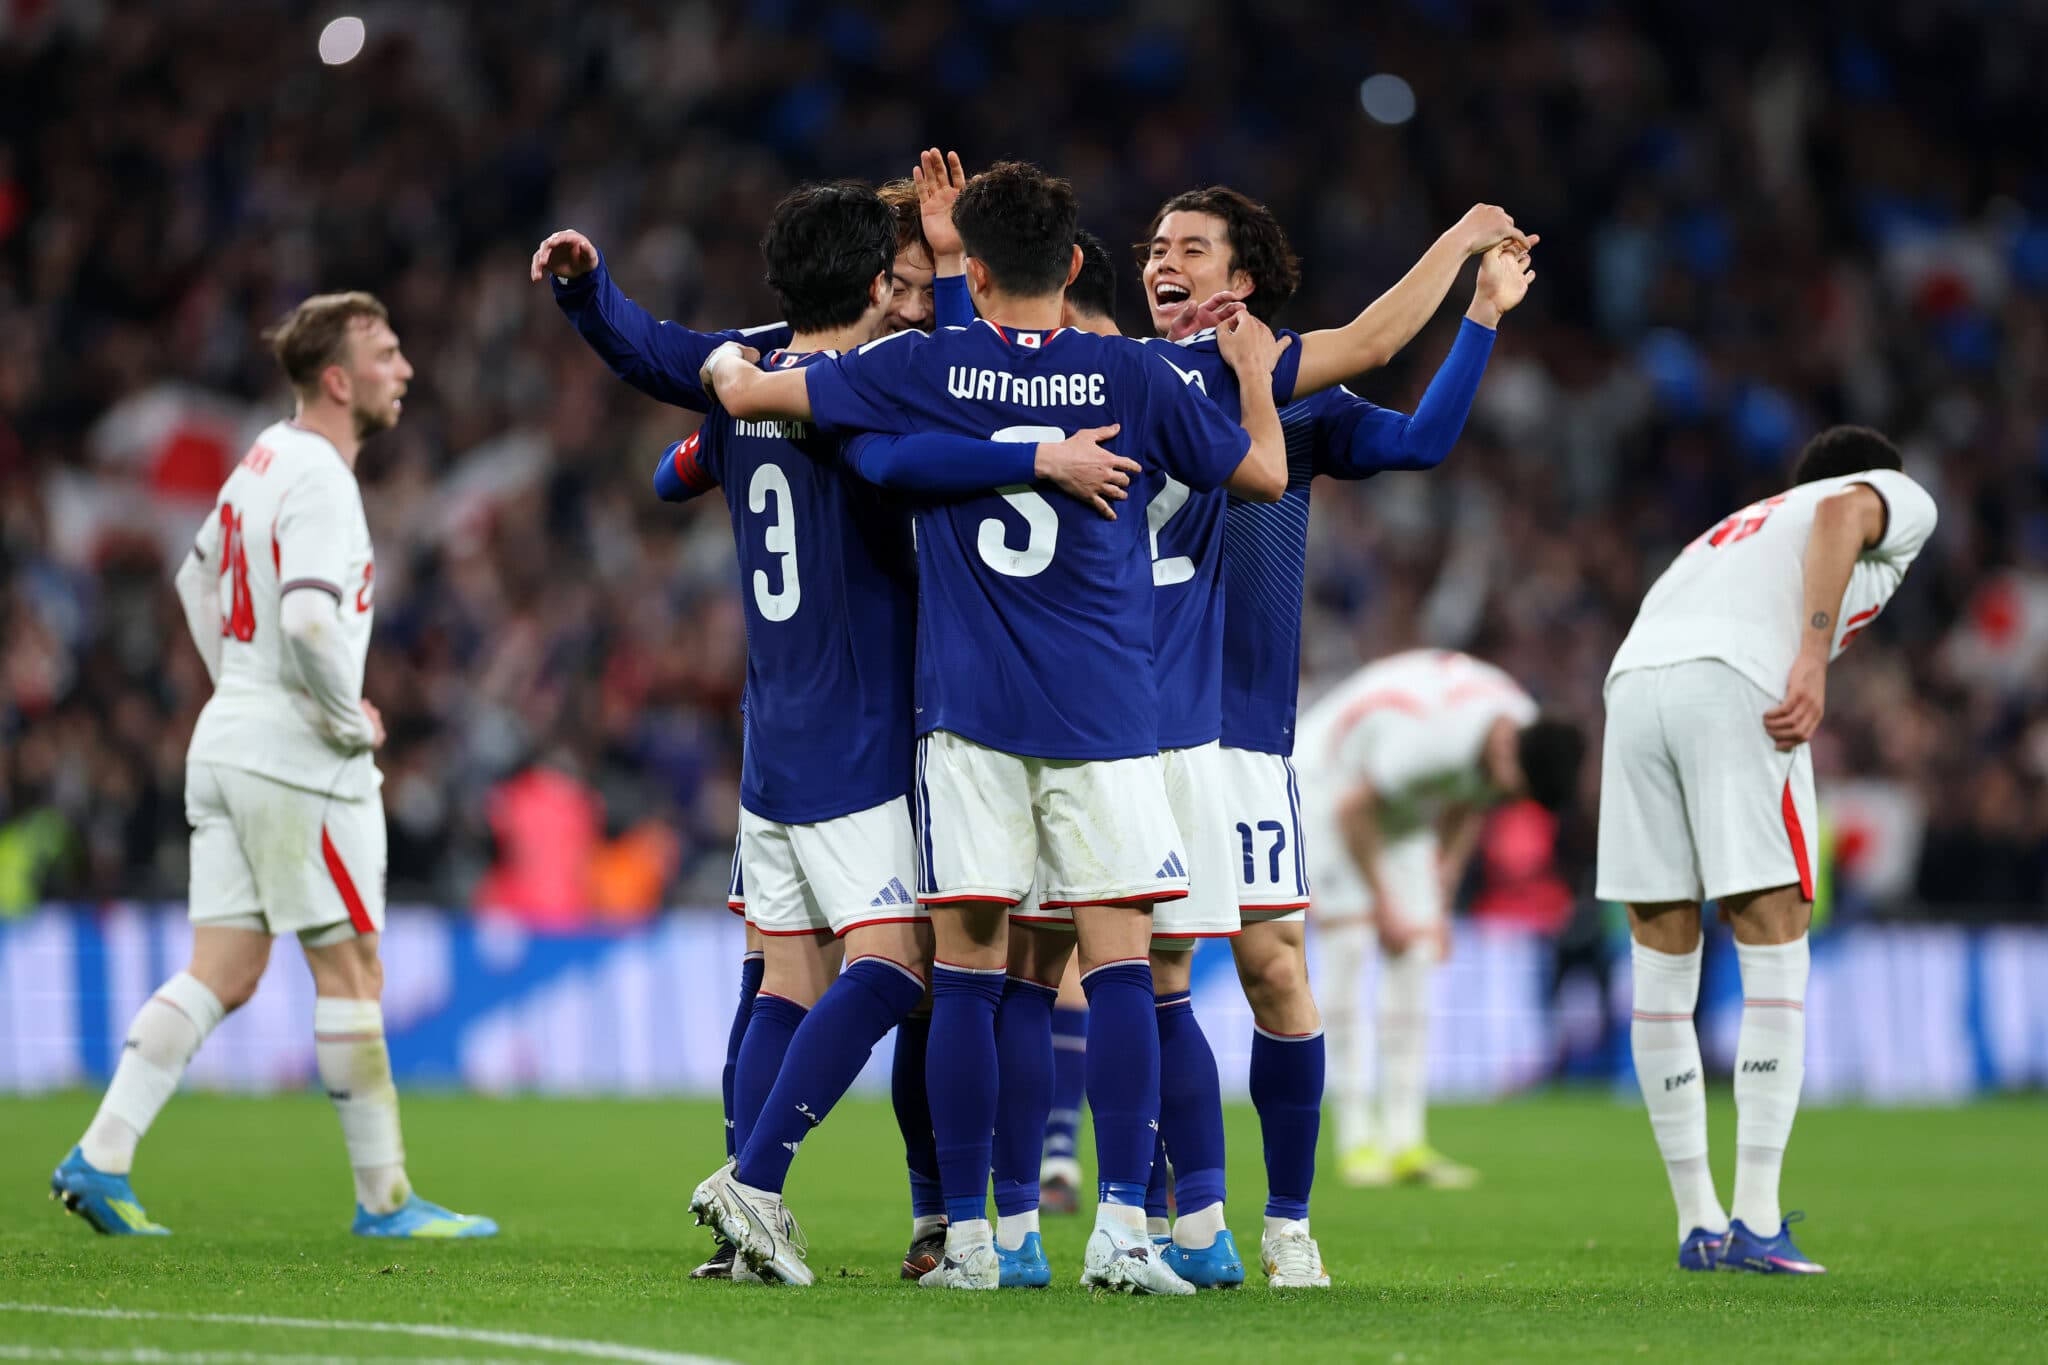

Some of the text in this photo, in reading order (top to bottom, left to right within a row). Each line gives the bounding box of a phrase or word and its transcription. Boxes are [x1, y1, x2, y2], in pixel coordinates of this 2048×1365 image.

[948, 366, 1105, 407] WATANABE
[749, 463, 800, 622] 3
[1236, 820, 1286, 884] 17
[1664, 1068, 1697, 1091] ENG
[1742, 1059, 1779, 1073] ENG
